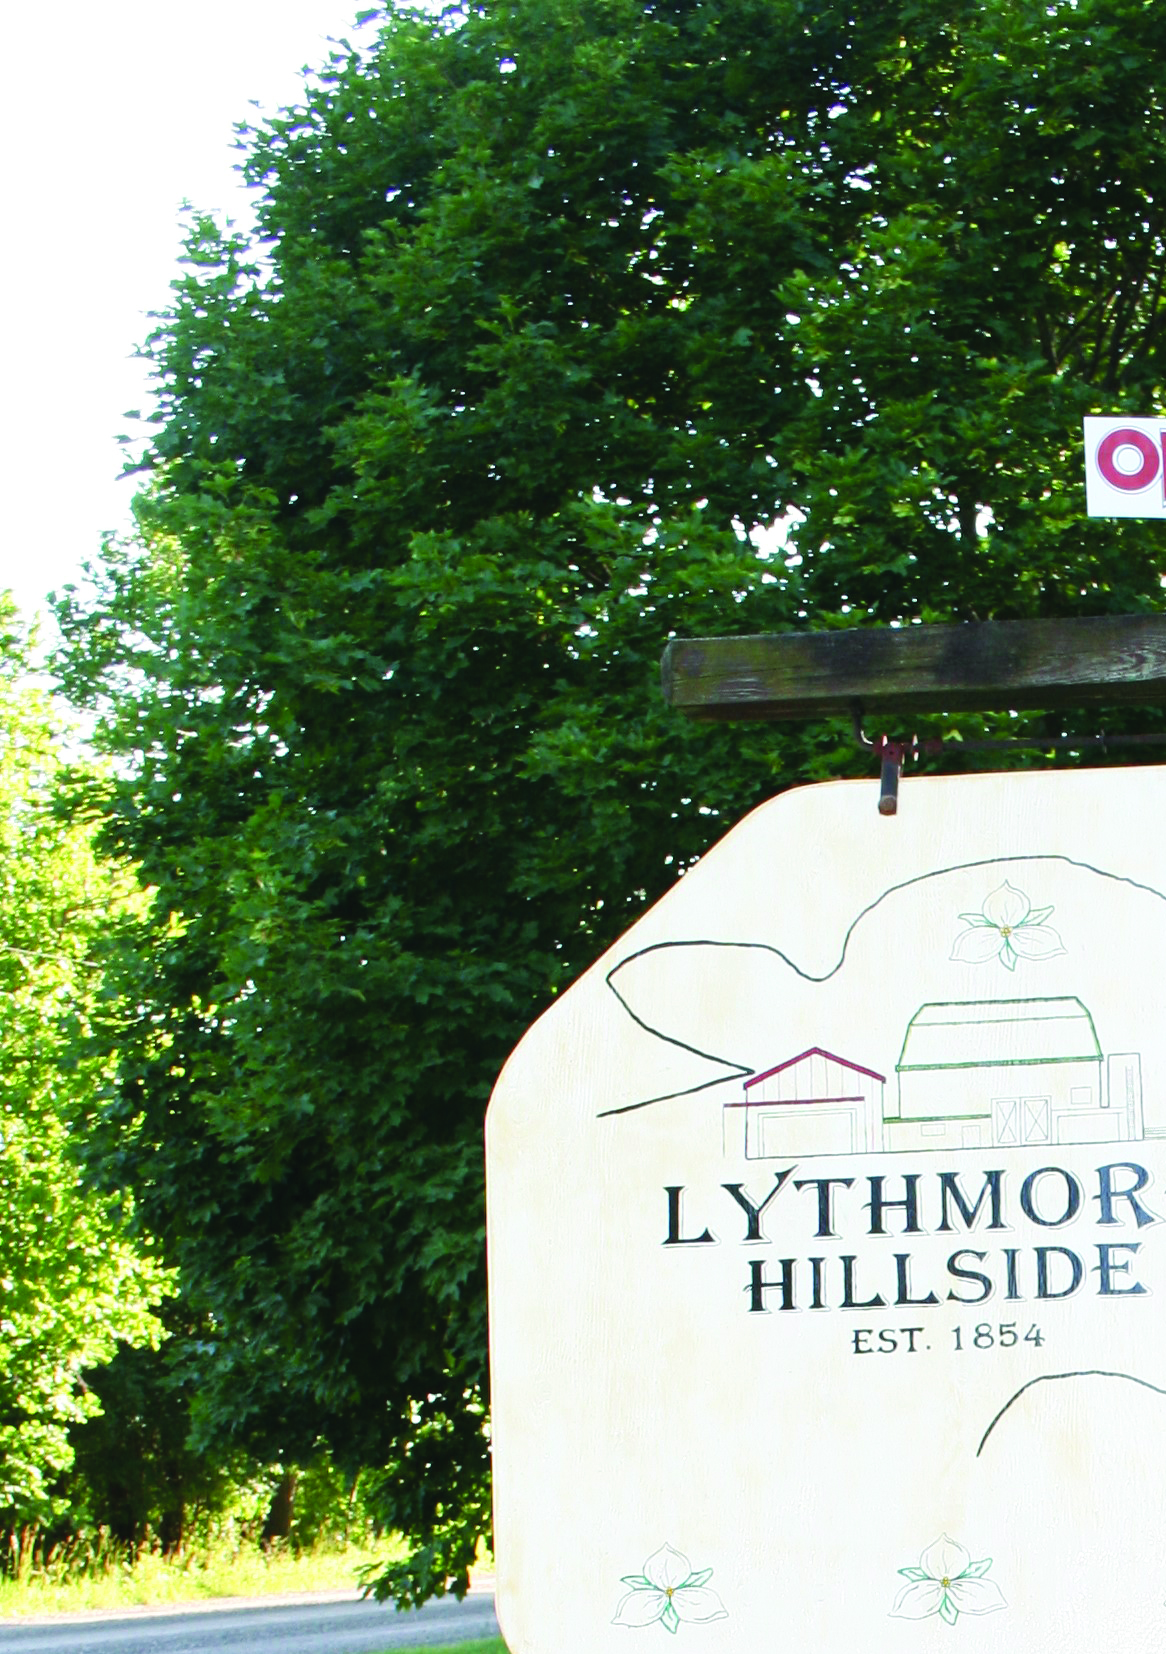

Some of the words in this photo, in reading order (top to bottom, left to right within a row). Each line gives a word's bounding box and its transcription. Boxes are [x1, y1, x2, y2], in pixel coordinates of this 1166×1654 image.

[743, 1242, 1150, 1313] HILLSIDE
[851, 1327, 932, 1354] EST.
[951, 1322, 1046, 1351] 1854
